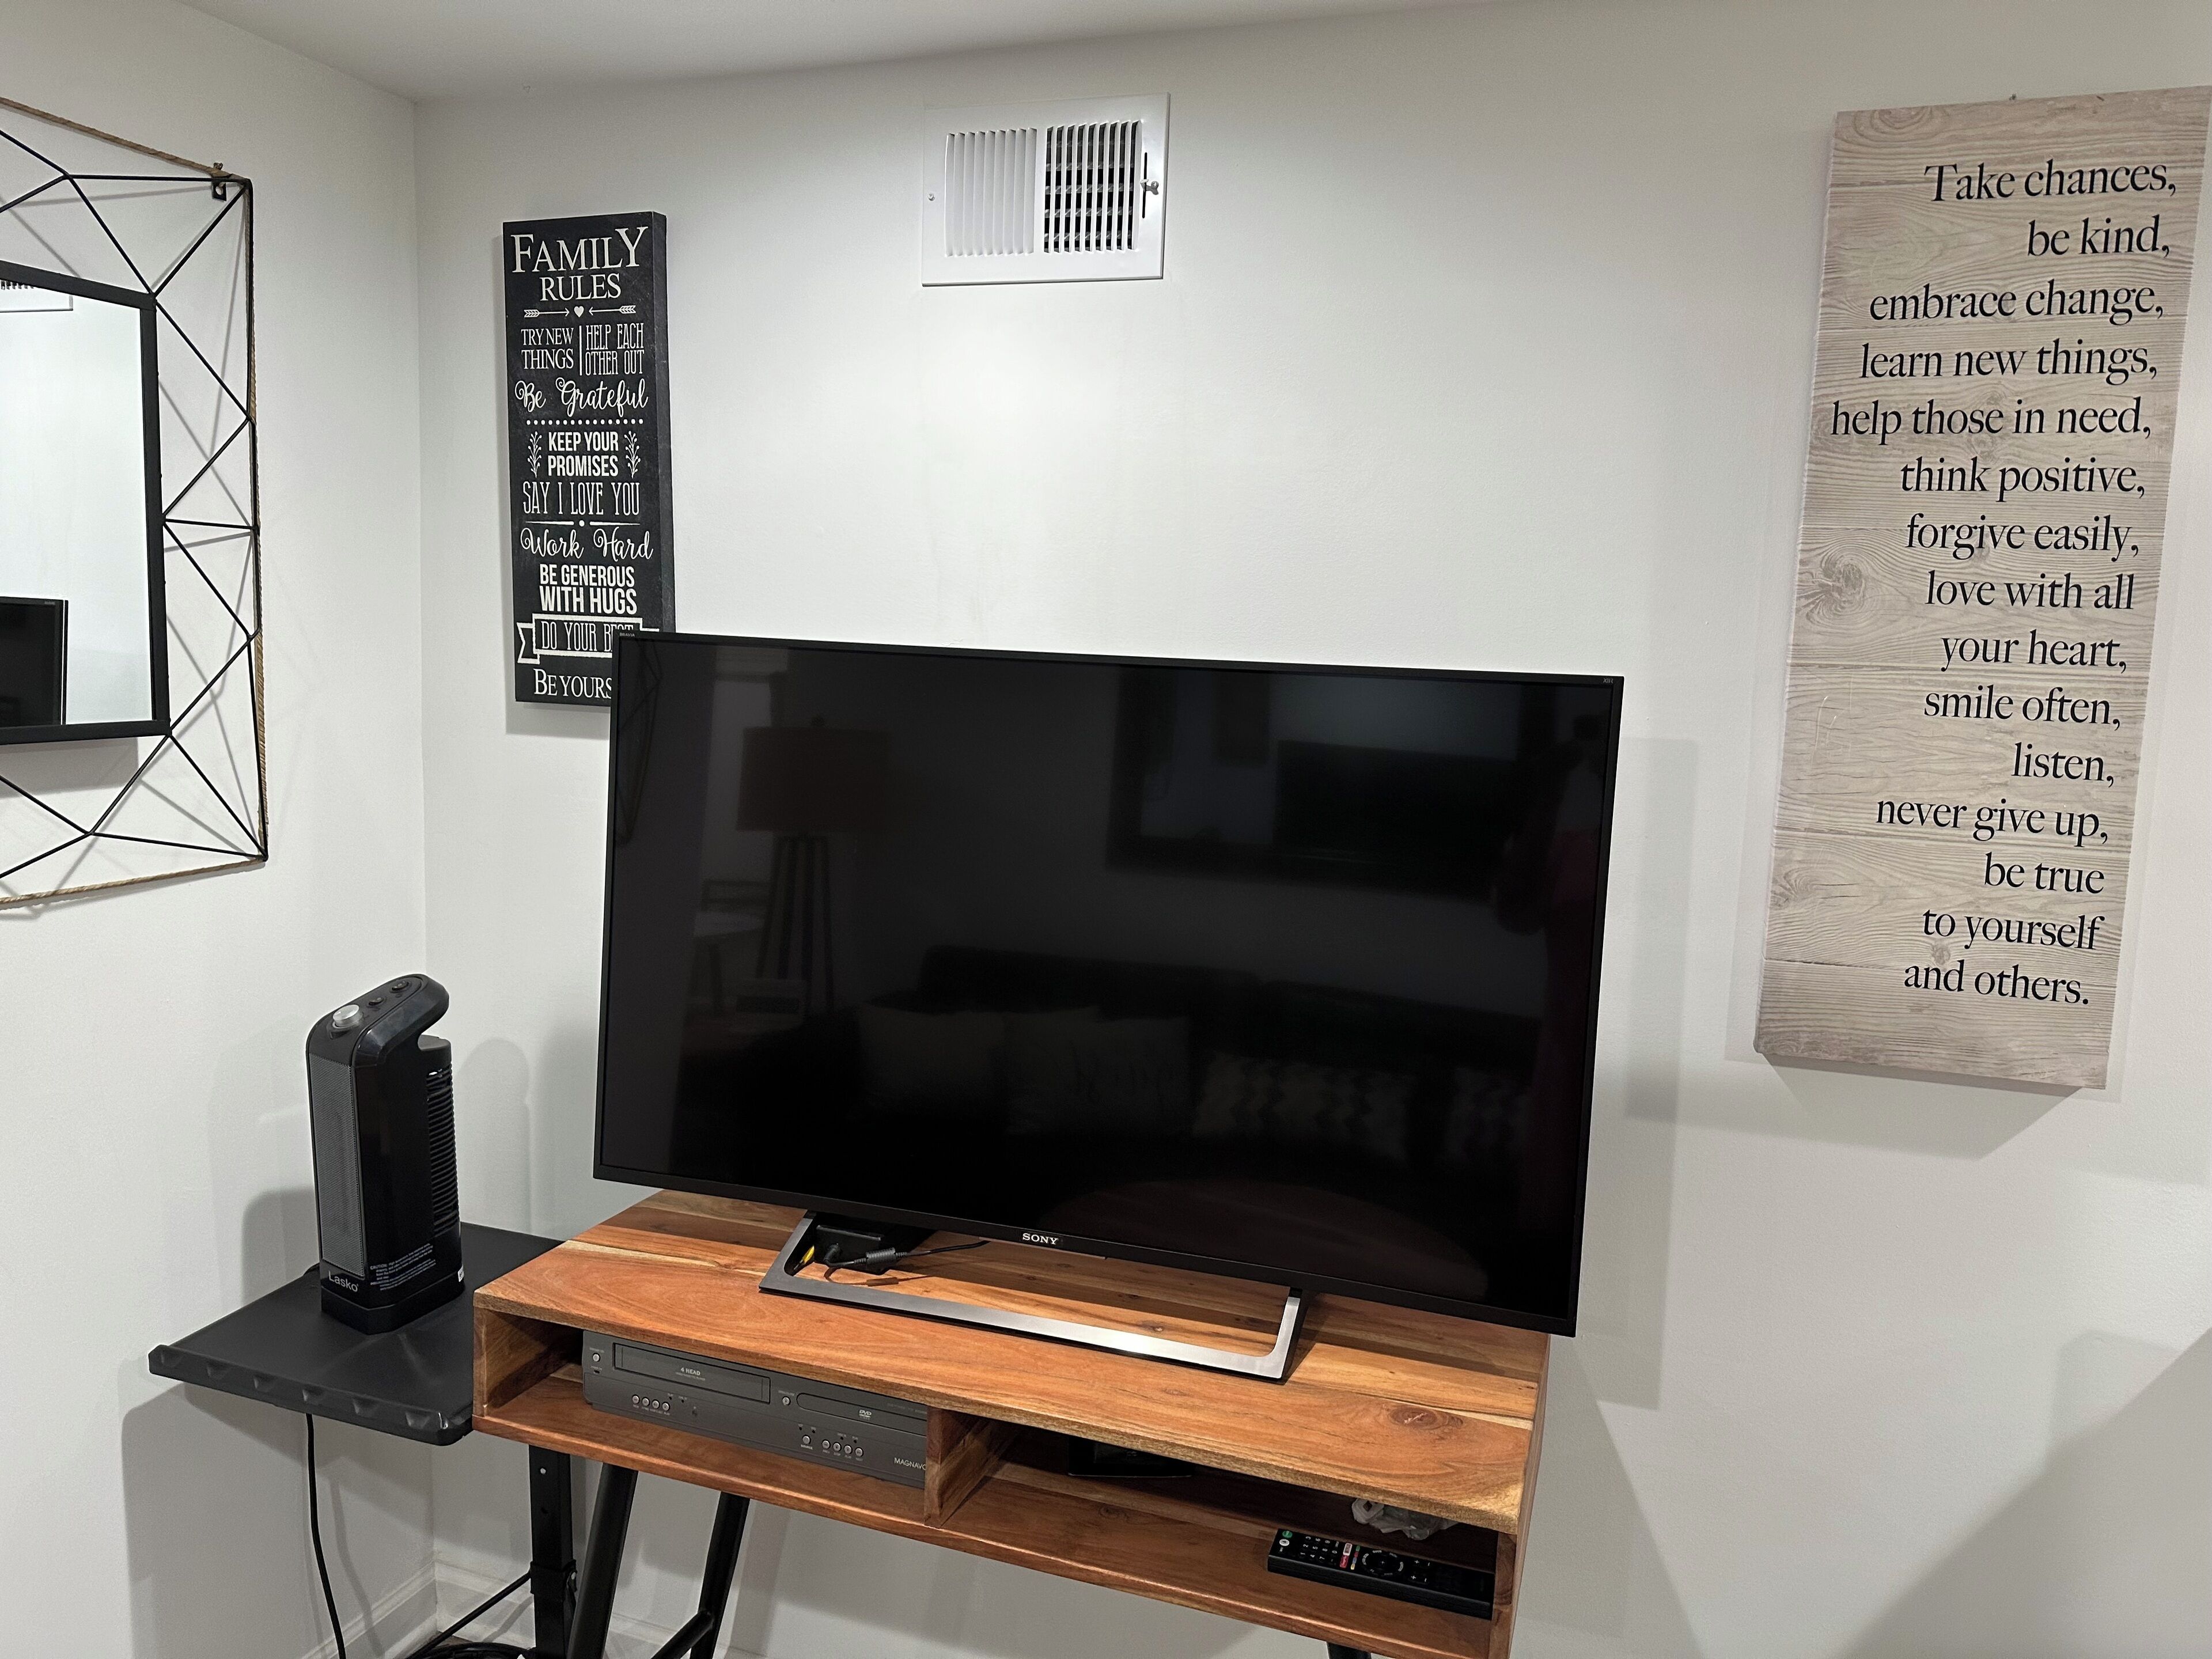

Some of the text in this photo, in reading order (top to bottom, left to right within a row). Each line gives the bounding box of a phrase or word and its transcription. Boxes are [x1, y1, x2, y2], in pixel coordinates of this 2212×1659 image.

[1925, 159, 2176, 201] Take chances,
[511, 226, 648, 272] FAMILY
[2028, 214, 2169, 257] be kind,
[540, 274, 621, 301] RULES
[1870, 279, 2162, 325] embrace change,
[521, 328, 574, 345] TRY NEW
[586, 323, 644, 350] HELP EACH
[521, 349, 573, 369] THINGS
[586, 350, 644, 376] OTHER OUT
[1859, 338, 2156, 385] learn new things,
[515, 377, 648, 417] Be Grateful
[1831, 396, 2150, 445] help those in need,
[549, 431, 618, 451] KEEP YOUR
[548, 455, 618, 476] PROMISES
[1901, 456, 2144, 502] think positive,
[523, 482, 639, 516] SAY I LOVE YOU
[521, 527, 653, 562] Work Hard
[1905, 513, 2138, 562] forgive easily,
[540, 564, 634, 588] BE GENEROUS
[1925, 570, 2134, 609] love with all
[540, 585, 637, 615] WITH HUGS
[541, 621, 558, 650] DO
[564, 622, 598, 652] YOUR
[1941, 629, 2126, 673] your heart,
[533, 669, 557, 695] BE
[1925, 684, 2120, 730] smile often,
[2012, 743, 2113, 787] listen,
[1876, 799, 2107, 847] never give up,
[1985, 852, 2104, 893] be true
[1923, 910, 2105, 949] to yourself
[1904, 960, 2088, 1004] and others.
[1022, 1233, 1058, 1244] SONY
[328, 1271, 358, 1292] Lasko
